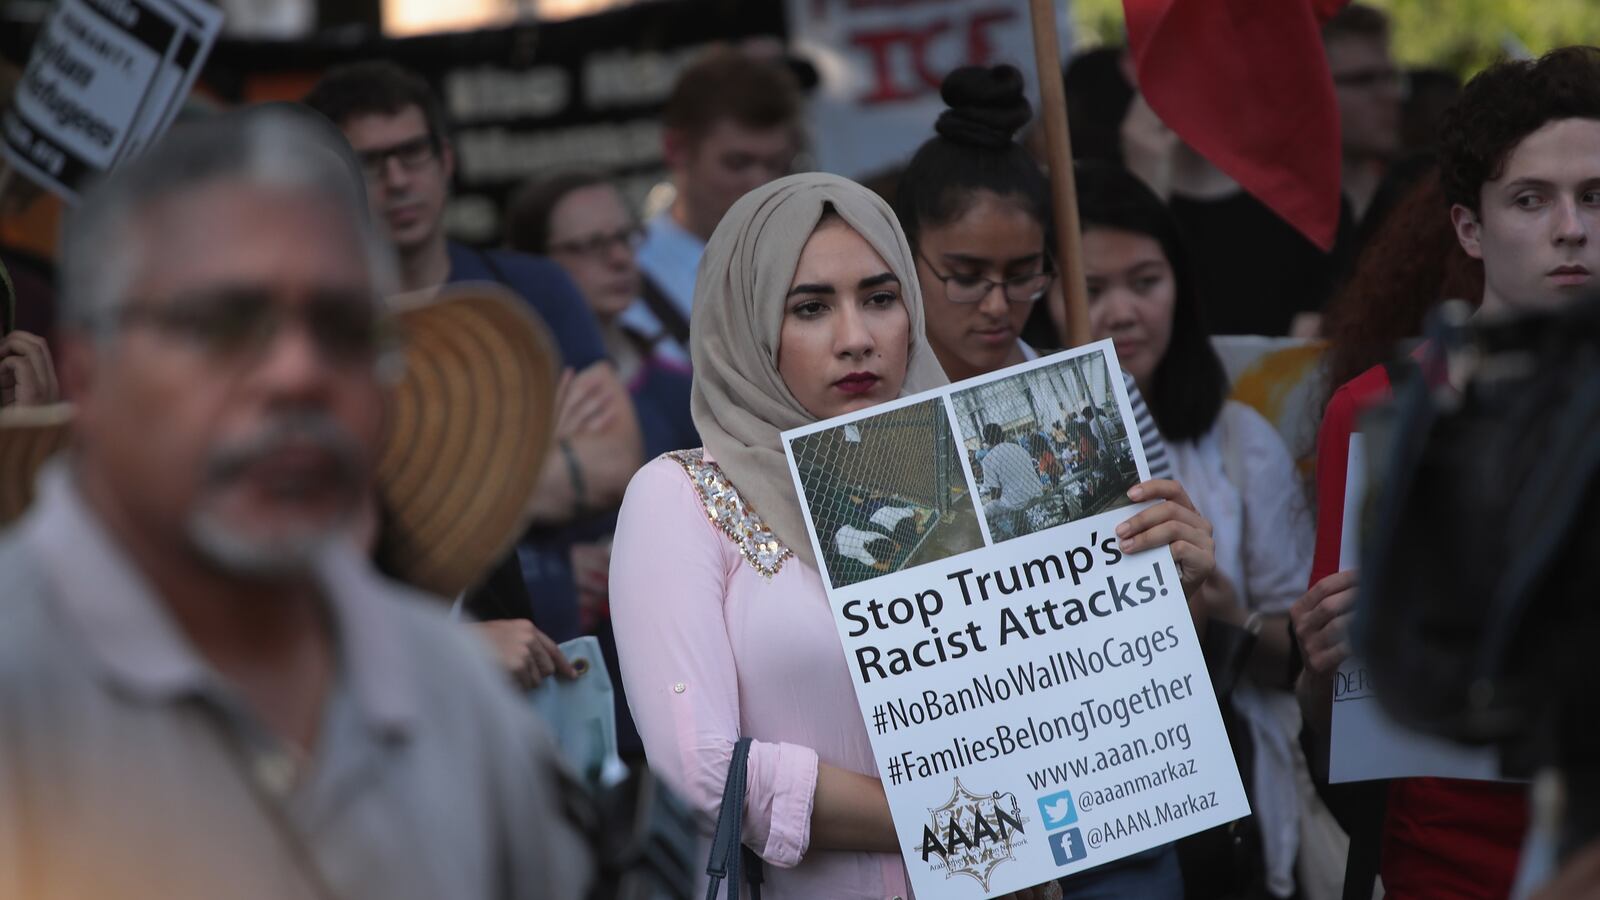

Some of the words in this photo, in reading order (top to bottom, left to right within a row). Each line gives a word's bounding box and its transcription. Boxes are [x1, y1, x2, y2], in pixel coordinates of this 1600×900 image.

[842, 587, 944, 637] Stop
[947, 531, 1123, 606] Trump's
[855, 620, 987, 683] Racist
[999, 562, 1169, 646] Attacks!
[872, 625, 1180, 735] #NoBanNoWallNoCages
[887, 673, 1195, 786] #FamliesBelongTogether
[1027, 723, 1192, 791] www.aaan.org
[922, 791, 1025, 863] AAAN
[1078, 758, 1198, 812] @aaanmarkaz
[1087, 791, 1219, 849] @AAAN.Markaz
